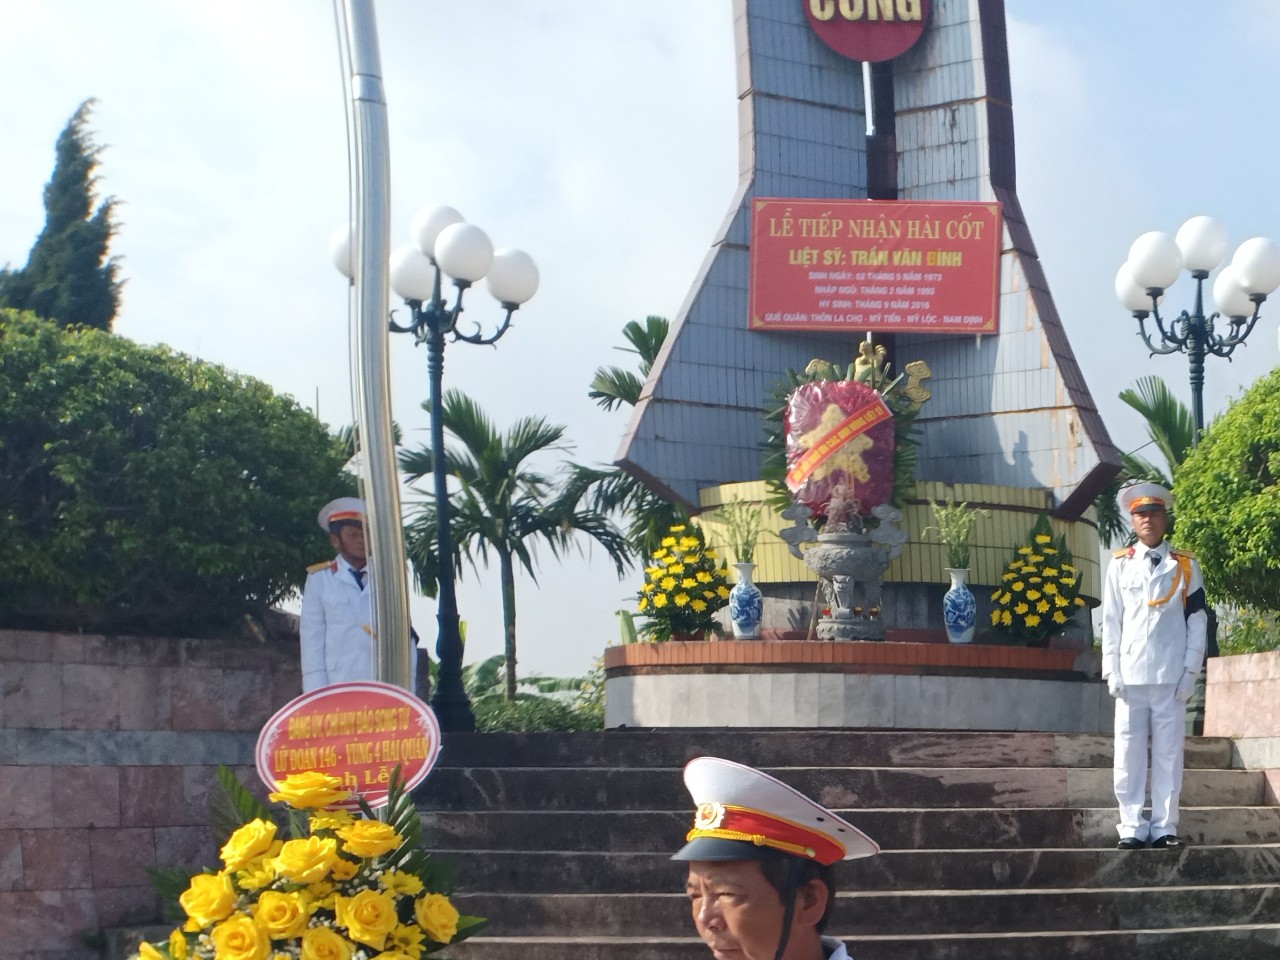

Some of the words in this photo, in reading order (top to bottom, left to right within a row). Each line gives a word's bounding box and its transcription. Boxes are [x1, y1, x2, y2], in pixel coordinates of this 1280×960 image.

[770, 208, 793, 237] LỄ
[799, 212, 843, 237] TIẾP
[848, 214, 901, 243] NHẬN
[907, 215, 940, 238] HÀI
[946, 213, 984, 239] CỐT
[789, 247, 818, 268] LIỆT
[893, 248, 922, 266] VĂN
[868, 271, 894, 280] THÁNG
[860, 285, 888, 295] THÁNG
[856, 299, 882, 308] THÁNG
[290, 742, 317, 770] ĐOÀN
[319, 745, 337, 768] 146
[346, 737, 373, 765] VÙNG
[374, 743, 380, 763] 4
[382, 733, 399, 761] HẢI
